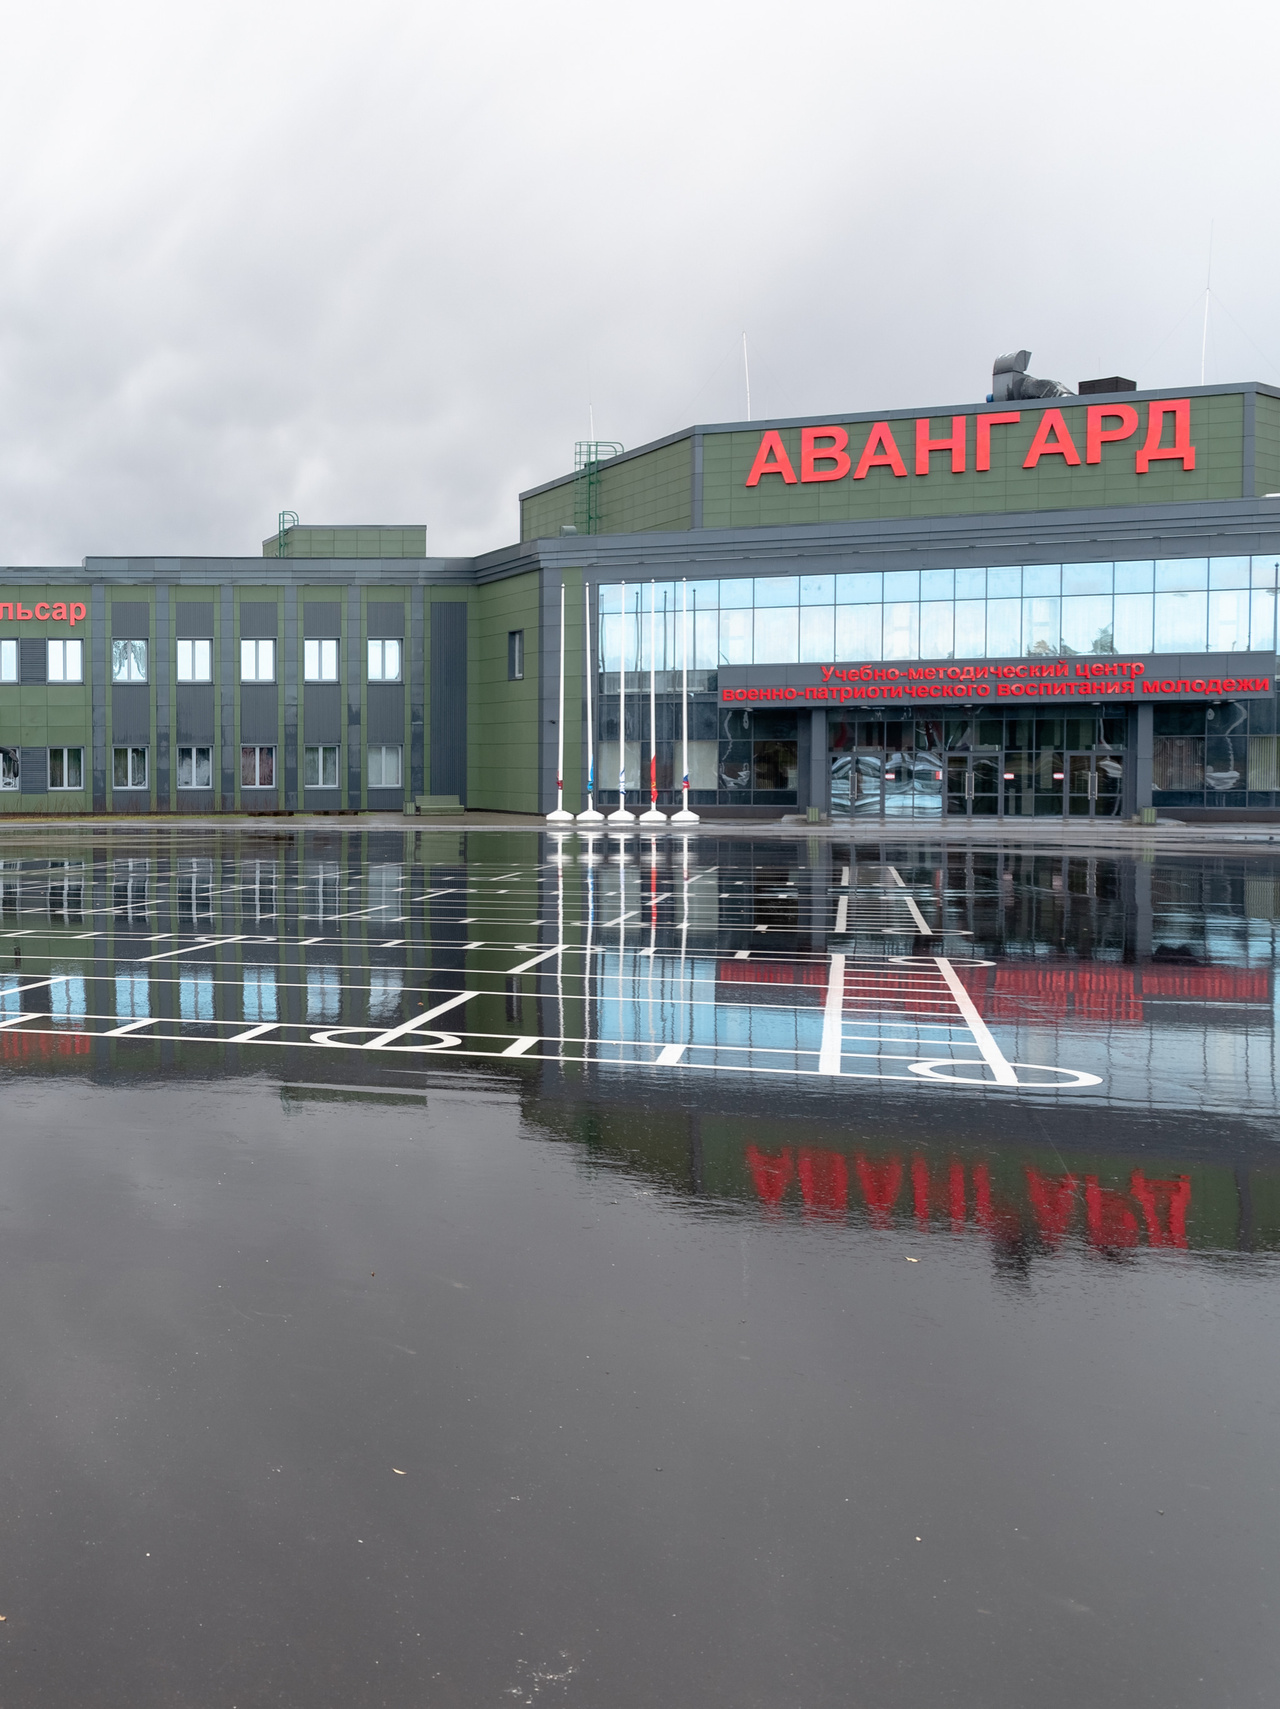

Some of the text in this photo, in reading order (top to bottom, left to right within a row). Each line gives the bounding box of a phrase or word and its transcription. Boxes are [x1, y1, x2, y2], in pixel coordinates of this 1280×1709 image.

[745, 399, 1196, 487] АВАНГАРД
[821, 660, 1145, 682] Учебно-методический центр
[722, 678, 1270, 702] военно-патриотического воспитания молодежи
